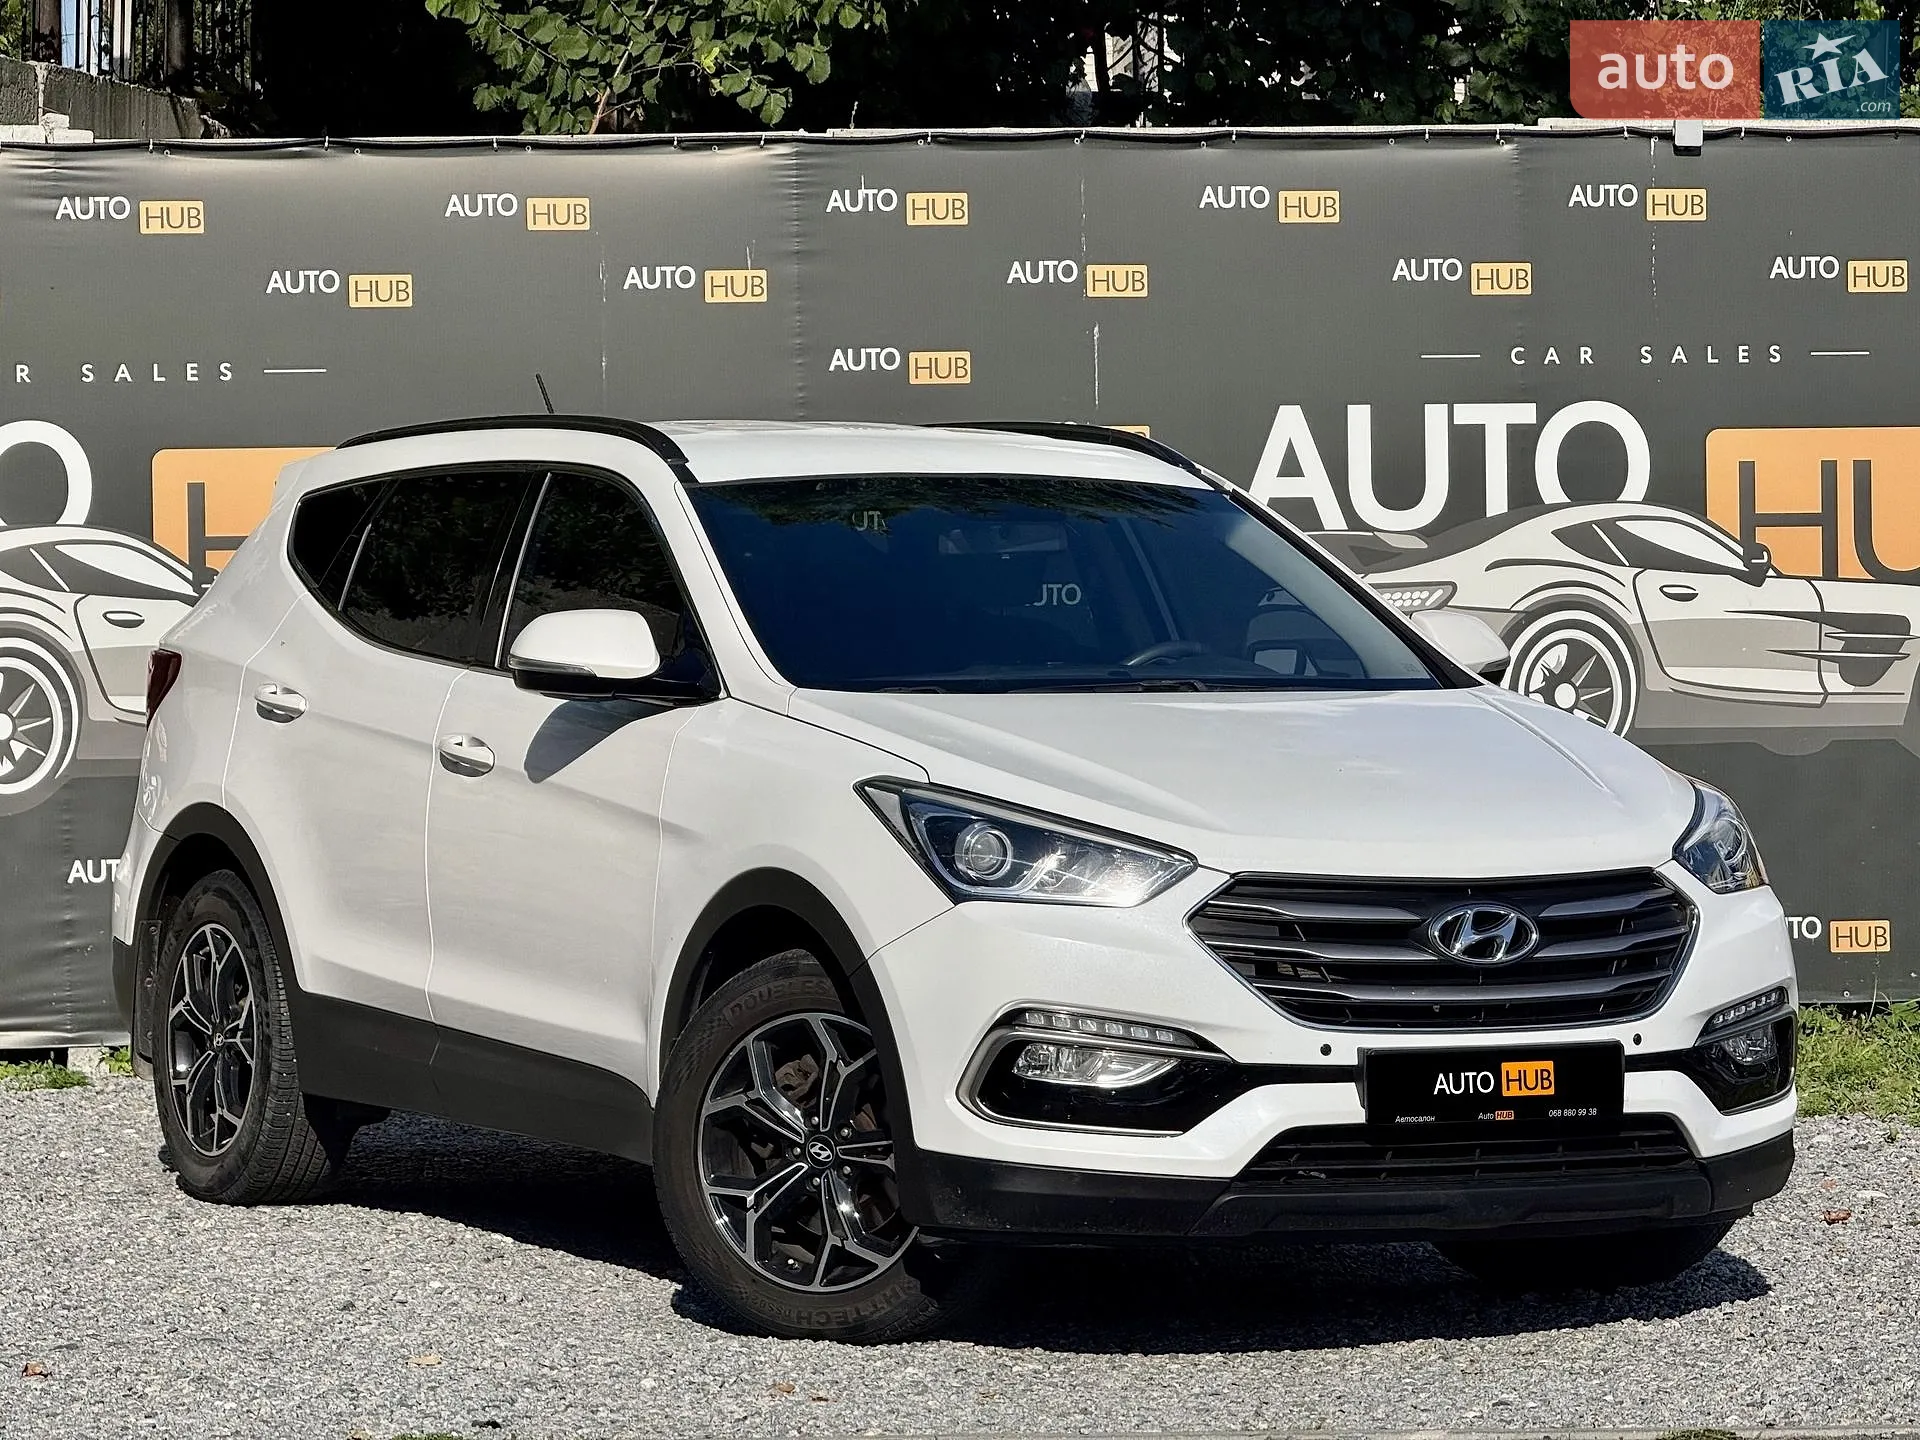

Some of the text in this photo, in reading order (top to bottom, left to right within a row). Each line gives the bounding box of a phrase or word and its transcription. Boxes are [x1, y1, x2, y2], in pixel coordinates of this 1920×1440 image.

[55, 196, 202, 230] AUTO HUB
[444, 192, 588, 226] AUTO HUB
[825, 188, 966, 221] AUTO HUB
[1199, 185, 1338, 219] AUTO HUB
[1568, 183, 1705, 216] AUTO HUB
[265, 269, 410, 303] AUTO HUB
[623, 265, 766, 298] AUTO HUB
[1006, 259, 1146, 293] AUTO HUB
[1391, 257, 1530, 291] AUTO HUB
[1769, 255, 1906, 288] AUTO HUB
[828, 347, 969, 380] AUTO HUB
[1510, 345, 1782, 365] CAR SALES
[81, 362, 233, 383] SALES
[1248, 400, 1920, 579] AUTO HU
[67, 858, 121, 884] AUT
[1835, 925, 1888, 949] HUB
[1433, 1068, 1553, 1095] AUTO HUB
[1394, 1115, 1436, 1123] Автосалон
[1478, 1111, 1513, 1120] Auto HUB
[1577, 1108, 1587, 1116] 99
[1588, 1107, 1597, 1116] 38
